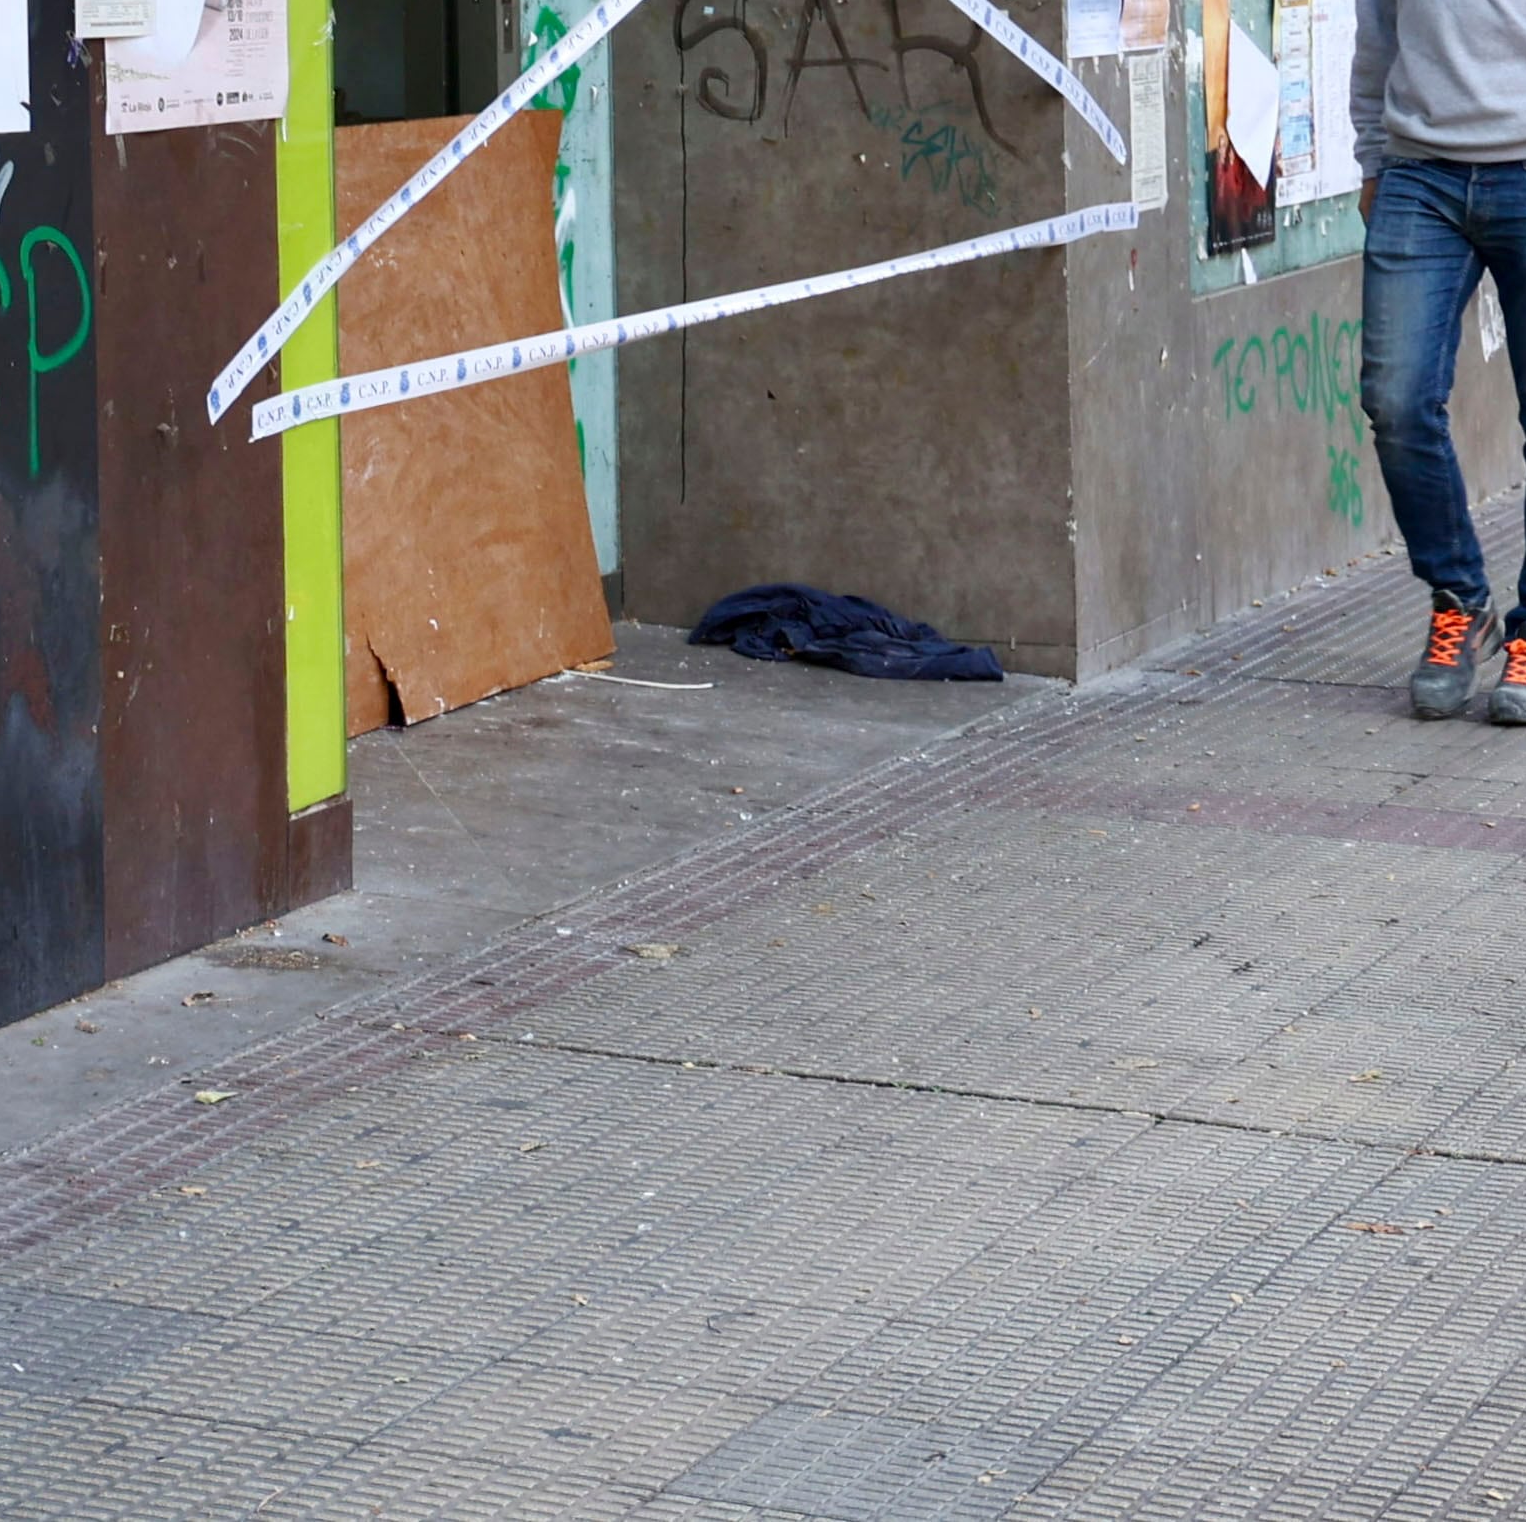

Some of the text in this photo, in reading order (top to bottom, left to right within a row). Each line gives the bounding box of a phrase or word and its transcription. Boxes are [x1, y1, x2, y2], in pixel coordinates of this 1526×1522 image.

[257, 406, 287, 430] C.N.P.
[306, 392, 333, 410] C.N.P.
[358, 381, 392, 400] C.N.P.
[417, 369, 450, 388] C.N.P.
[475, 356, 506, 375] C.N.P.
[528, 344, 559, 363] C.N.P.
